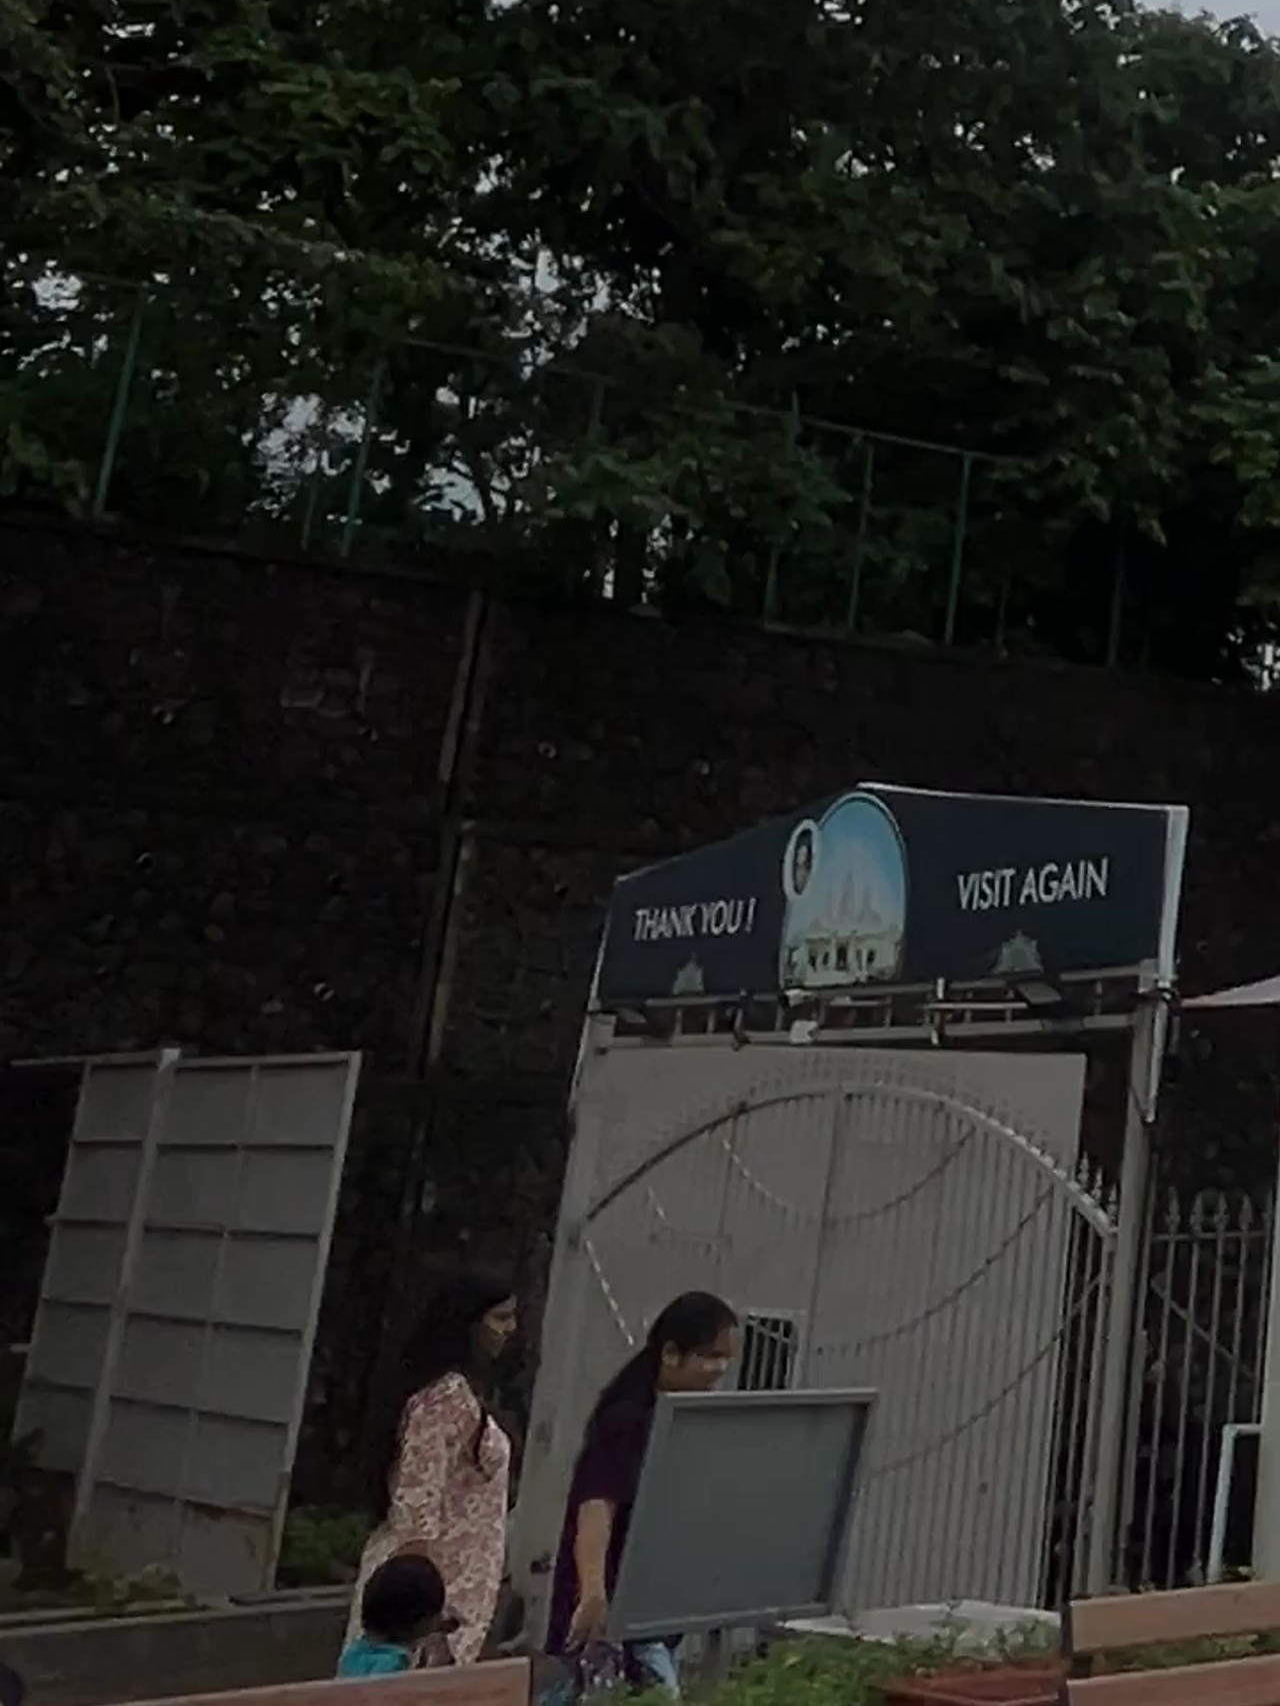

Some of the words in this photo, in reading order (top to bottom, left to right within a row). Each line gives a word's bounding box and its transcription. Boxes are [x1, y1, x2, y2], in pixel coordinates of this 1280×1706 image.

[957, 867, 1016, 911] VISIT
[1019, 856, 1109, 906] AGAIN
[633, 903, 698, 941] THANK
